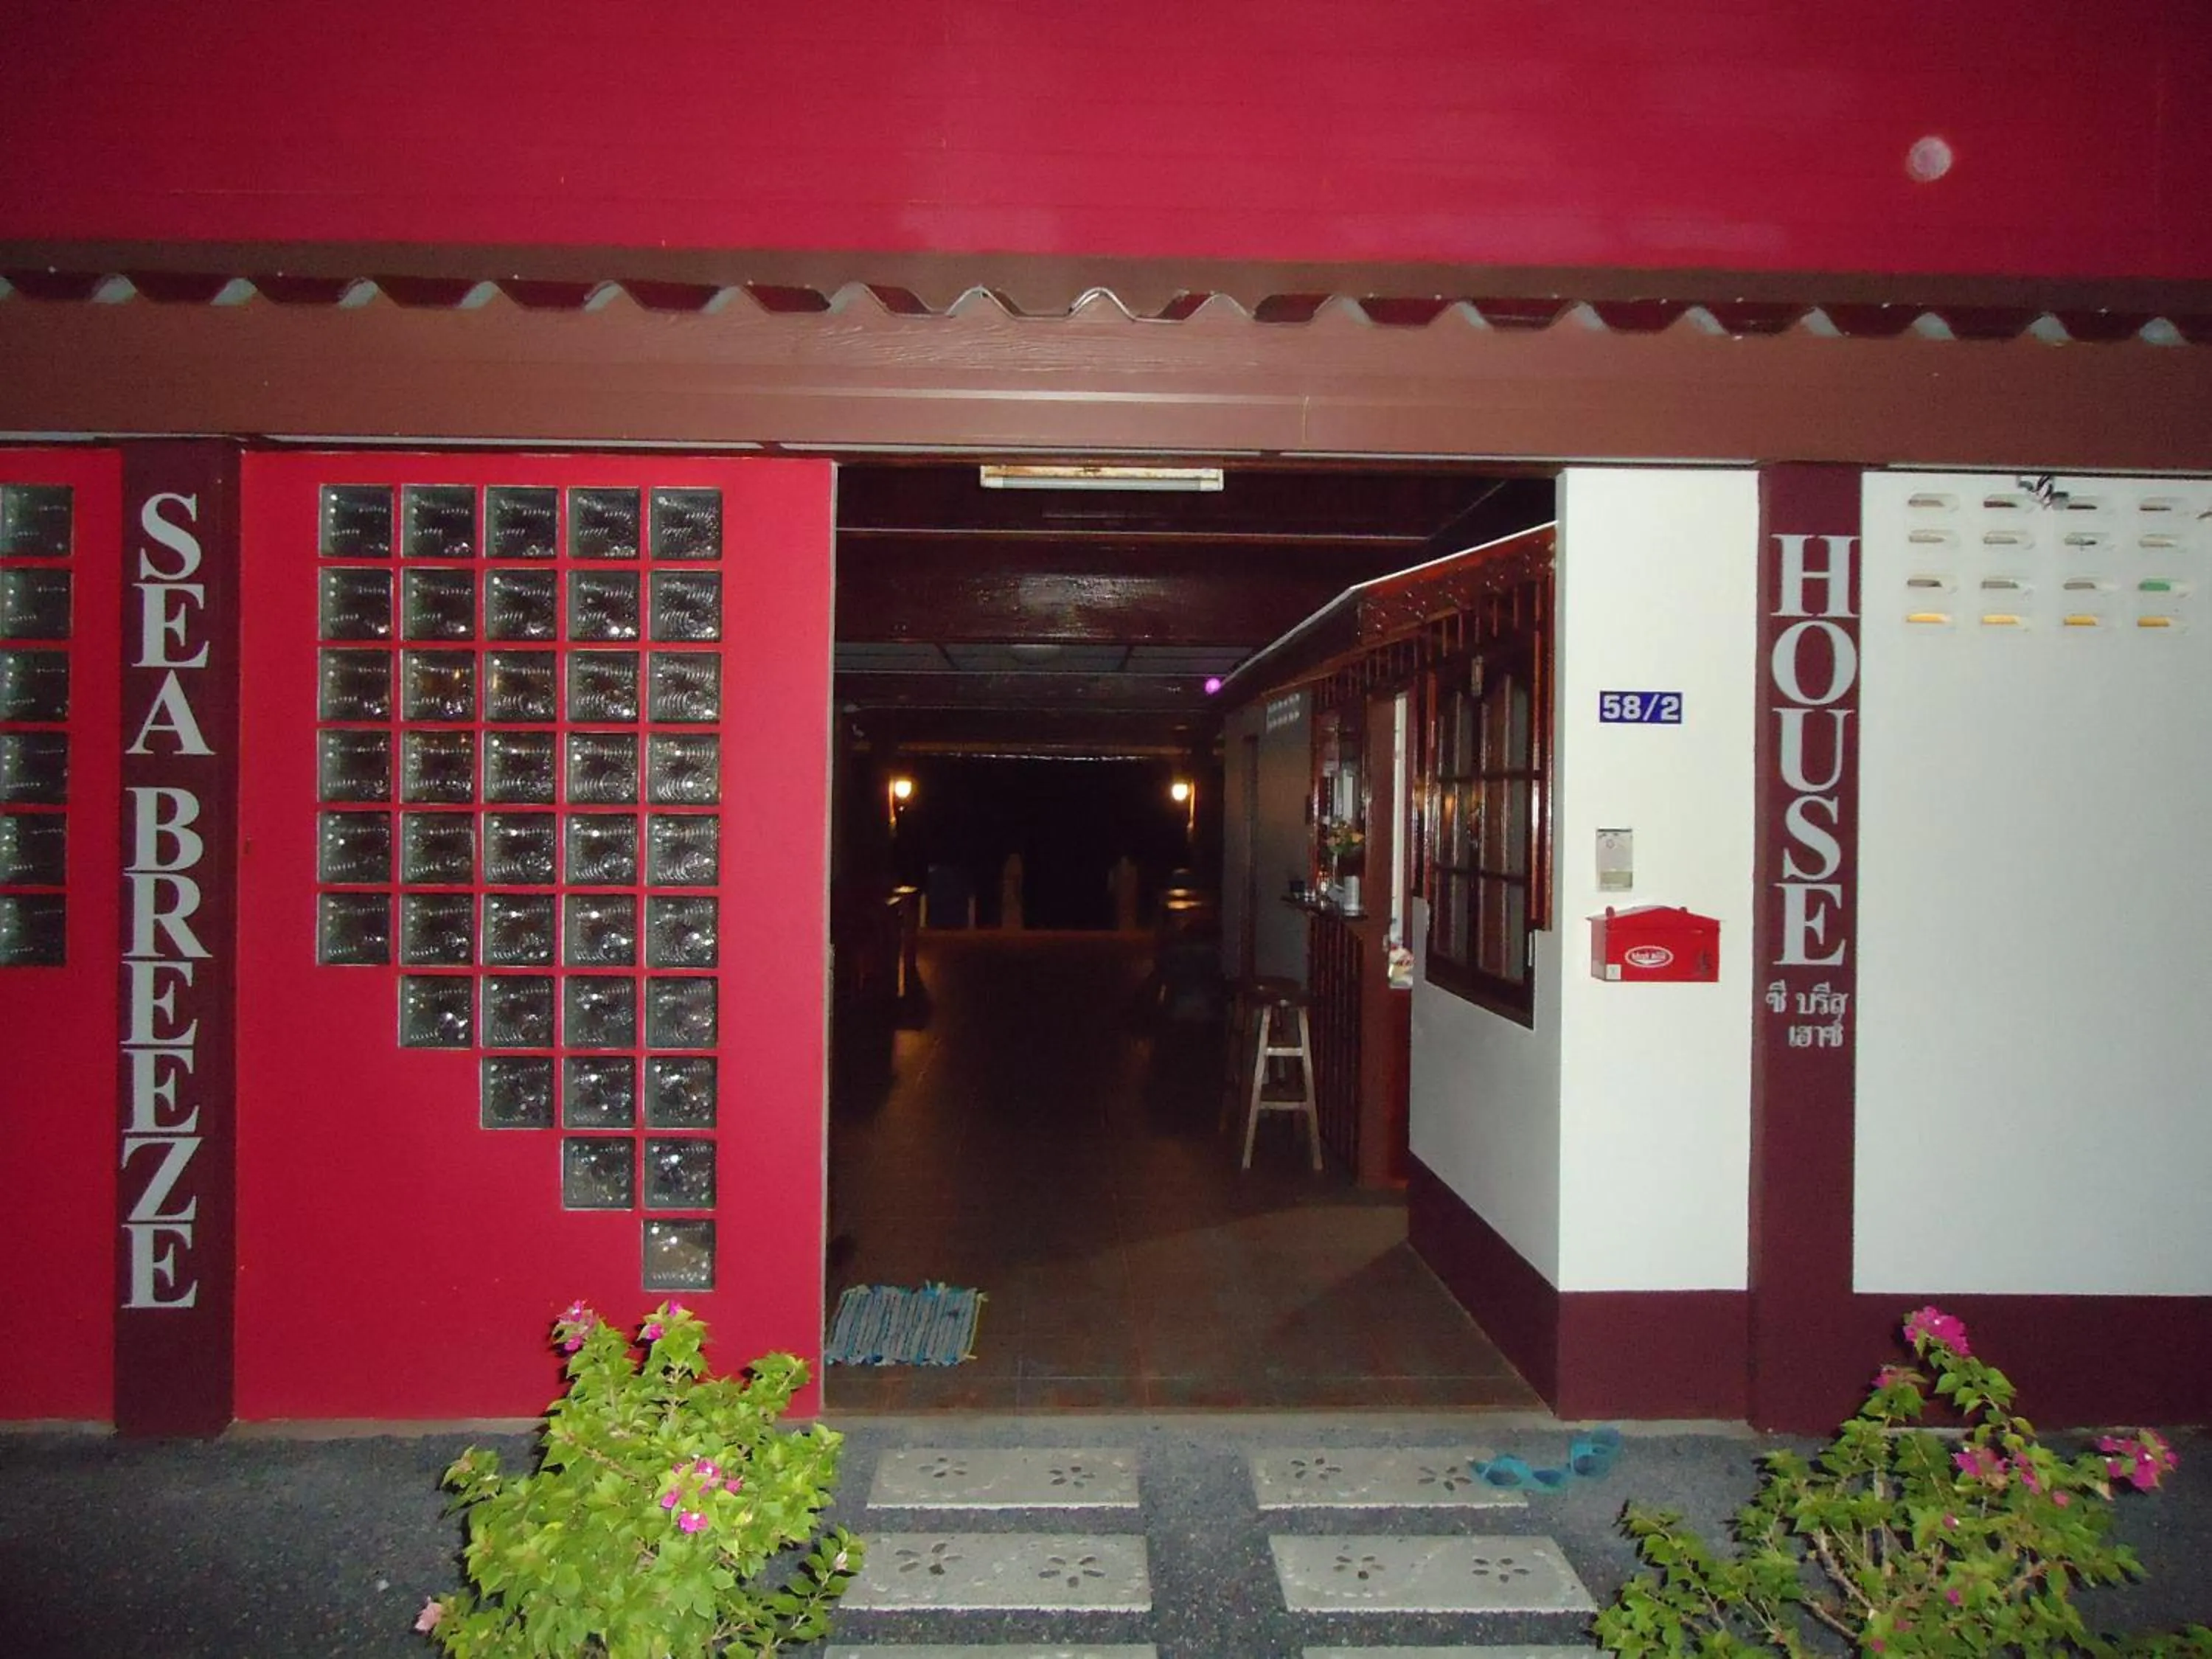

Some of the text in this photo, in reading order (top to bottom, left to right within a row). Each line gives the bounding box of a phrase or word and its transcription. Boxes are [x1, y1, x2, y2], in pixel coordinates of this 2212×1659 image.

[120, 493, 217, 1310] SEA BREEZE
[1602, 694, 1679, 721] 58/2
[1770, 534, 1860, 966] HOUSE
